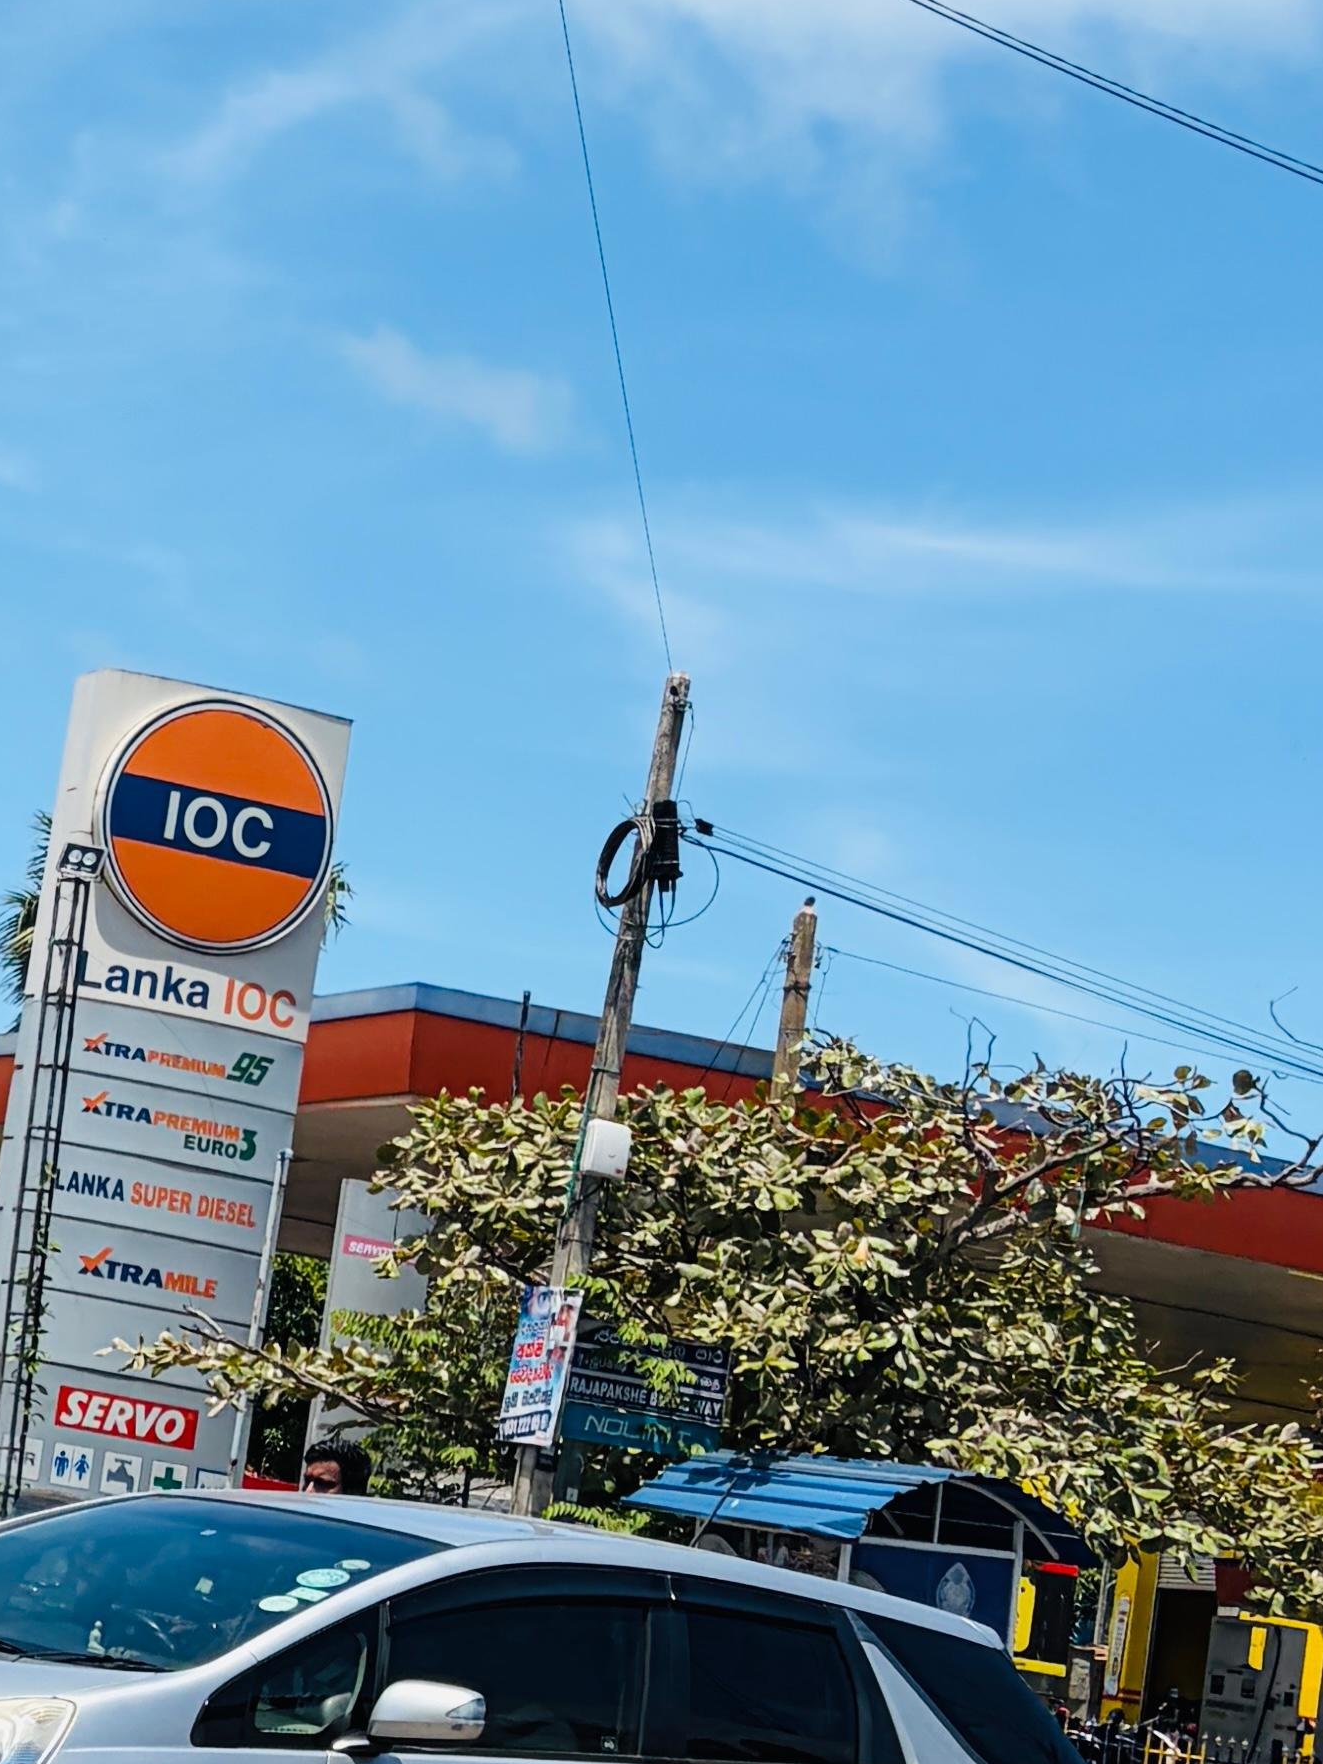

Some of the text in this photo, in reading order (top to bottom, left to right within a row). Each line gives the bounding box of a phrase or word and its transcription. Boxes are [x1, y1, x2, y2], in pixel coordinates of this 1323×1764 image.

[163, 790, 274, 859] IOC
[77, 950, 298, 1029] Lanka IOC
[226, 1051, 275, 1086] 95
[54, 1168, 257, 1229] LANKA SUPER DIESEL
[59, 1391, 186, 1443] SERVO
[569, 1376, 647, 1405] RAJAPAKSHE
